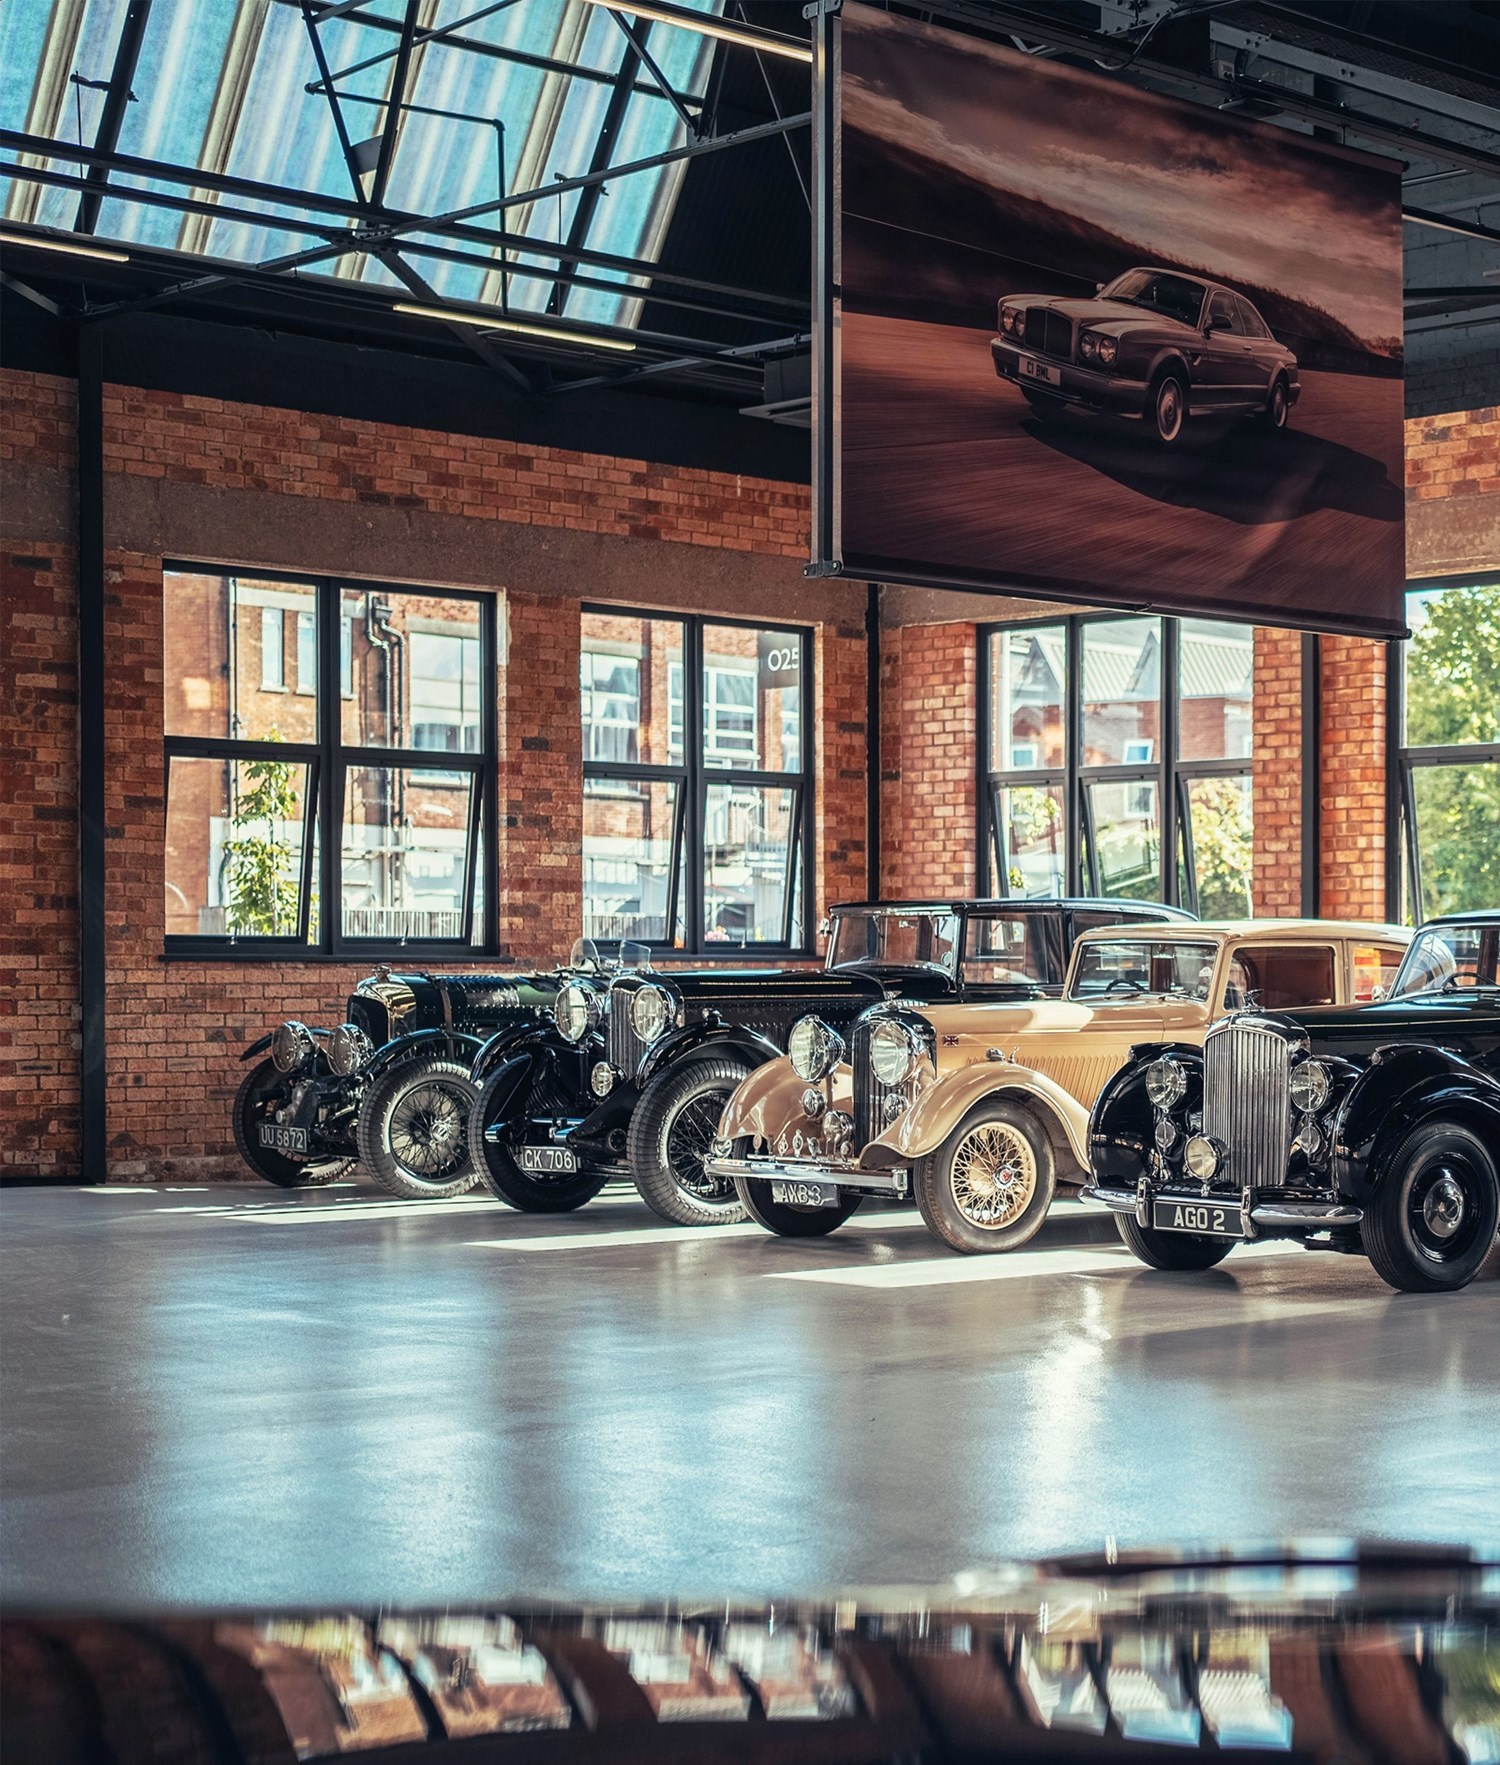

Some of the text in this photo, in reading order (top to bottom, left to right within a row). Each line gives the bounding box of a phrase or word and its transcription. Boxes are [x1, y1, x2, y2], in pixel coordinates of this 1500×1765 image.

[767, 647, 799, 672] 025
[261, 1126, 304, 1149] UU 5872
[546, 1150, 573, 1170] 706
[1173, 1205, 1225, 1231] AGO 2
